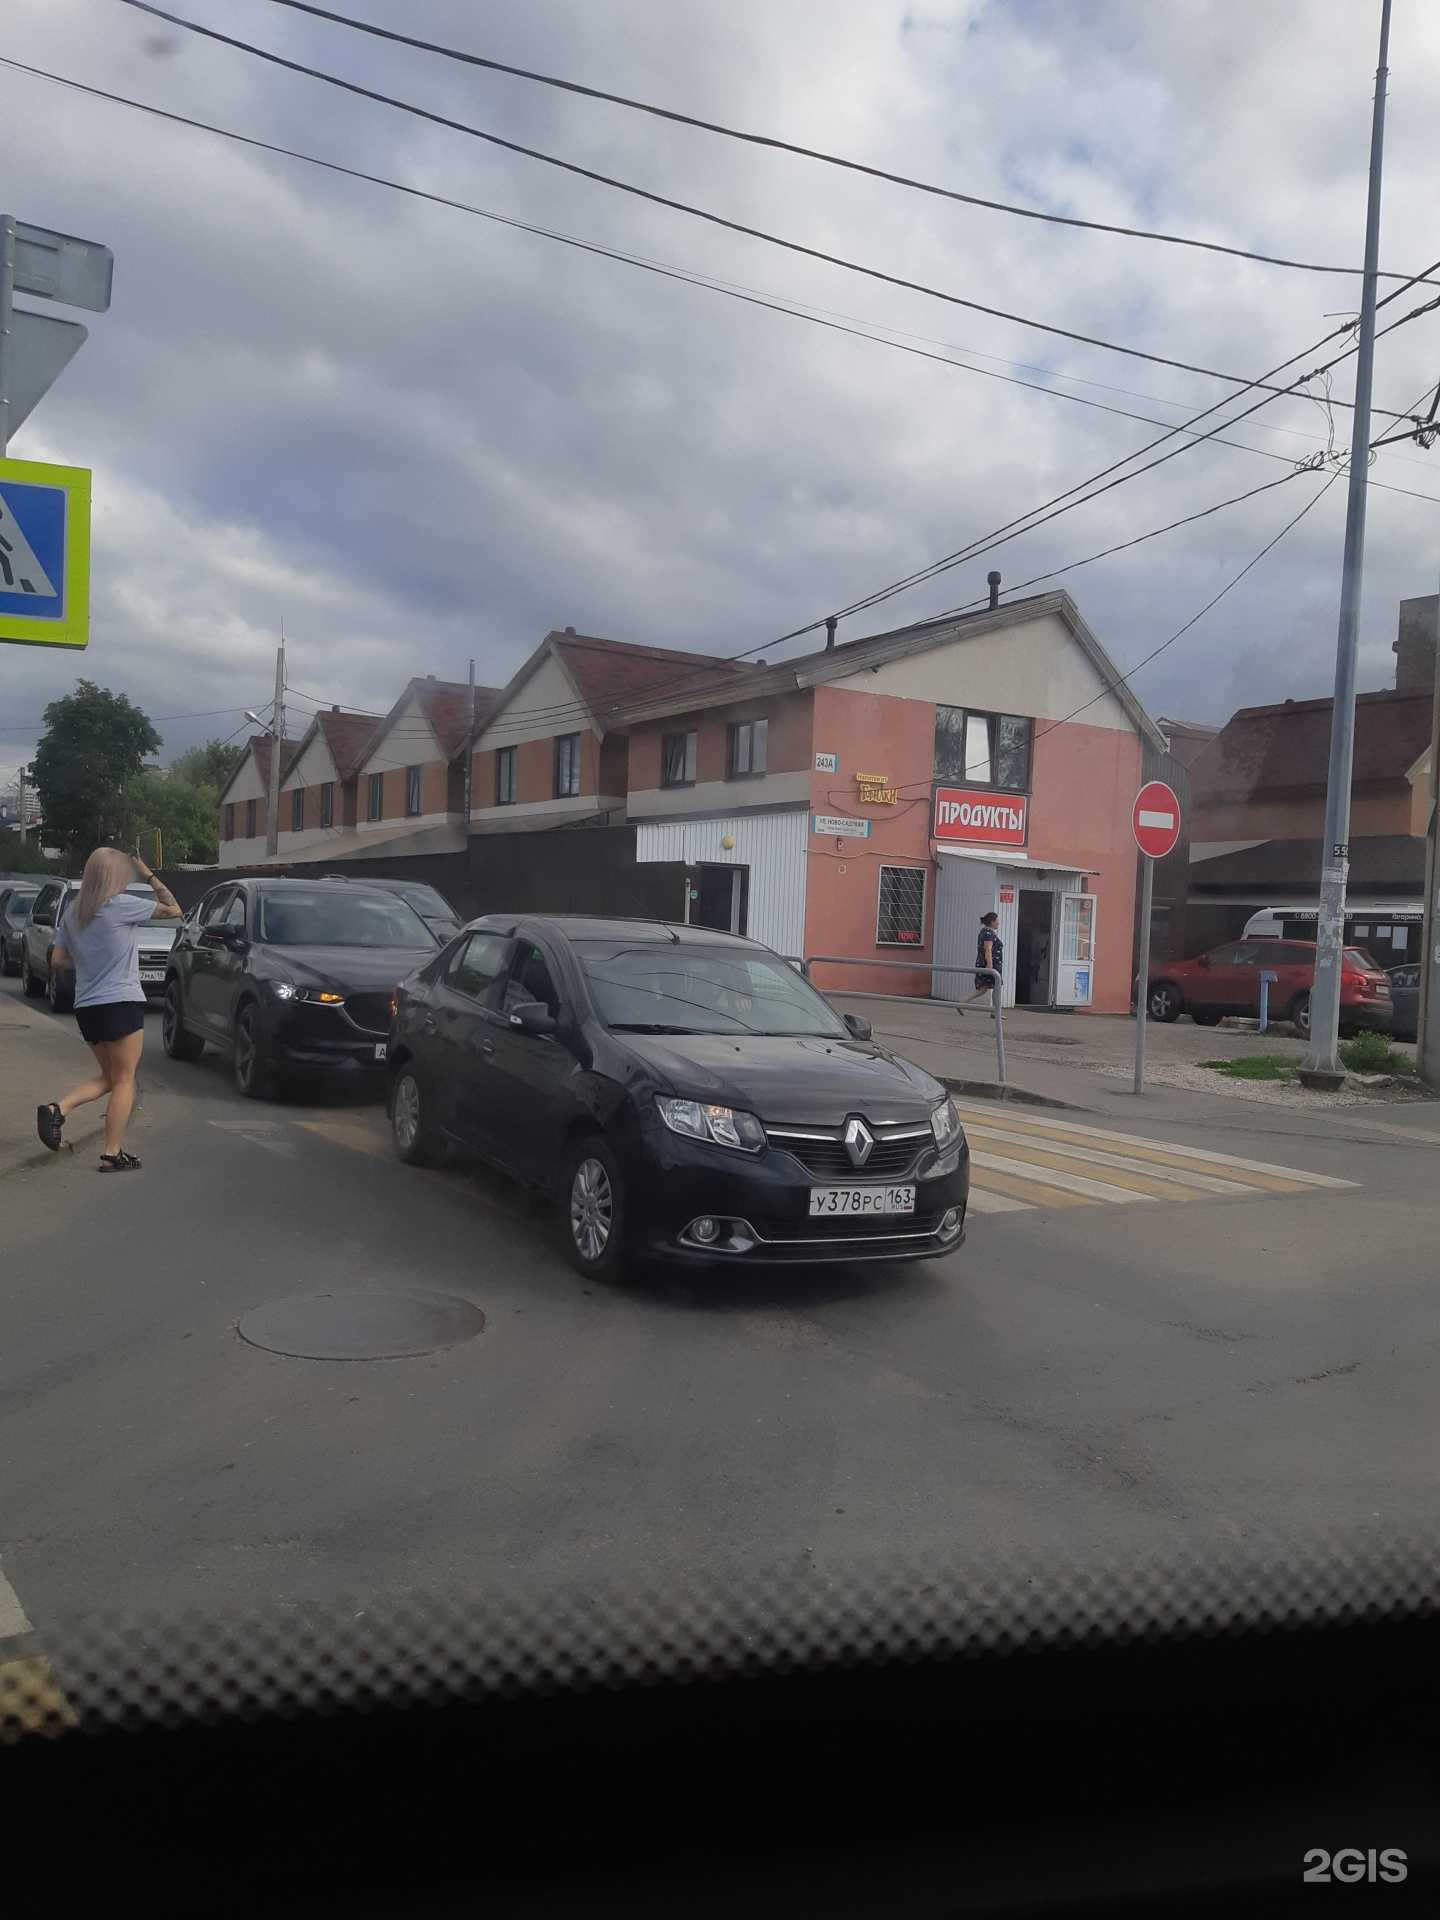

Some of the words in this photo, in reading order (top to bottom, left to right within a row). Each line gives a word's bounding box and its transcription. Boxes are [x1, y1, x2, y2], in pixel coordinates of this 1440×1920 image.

[817, 757, 833, 769] 243А
[938, 800, 1024, 831] ПРОДУКТЫ
[816, 1191, 883, 1212] У378РС
[887, 1188, 911, 1205] 163
